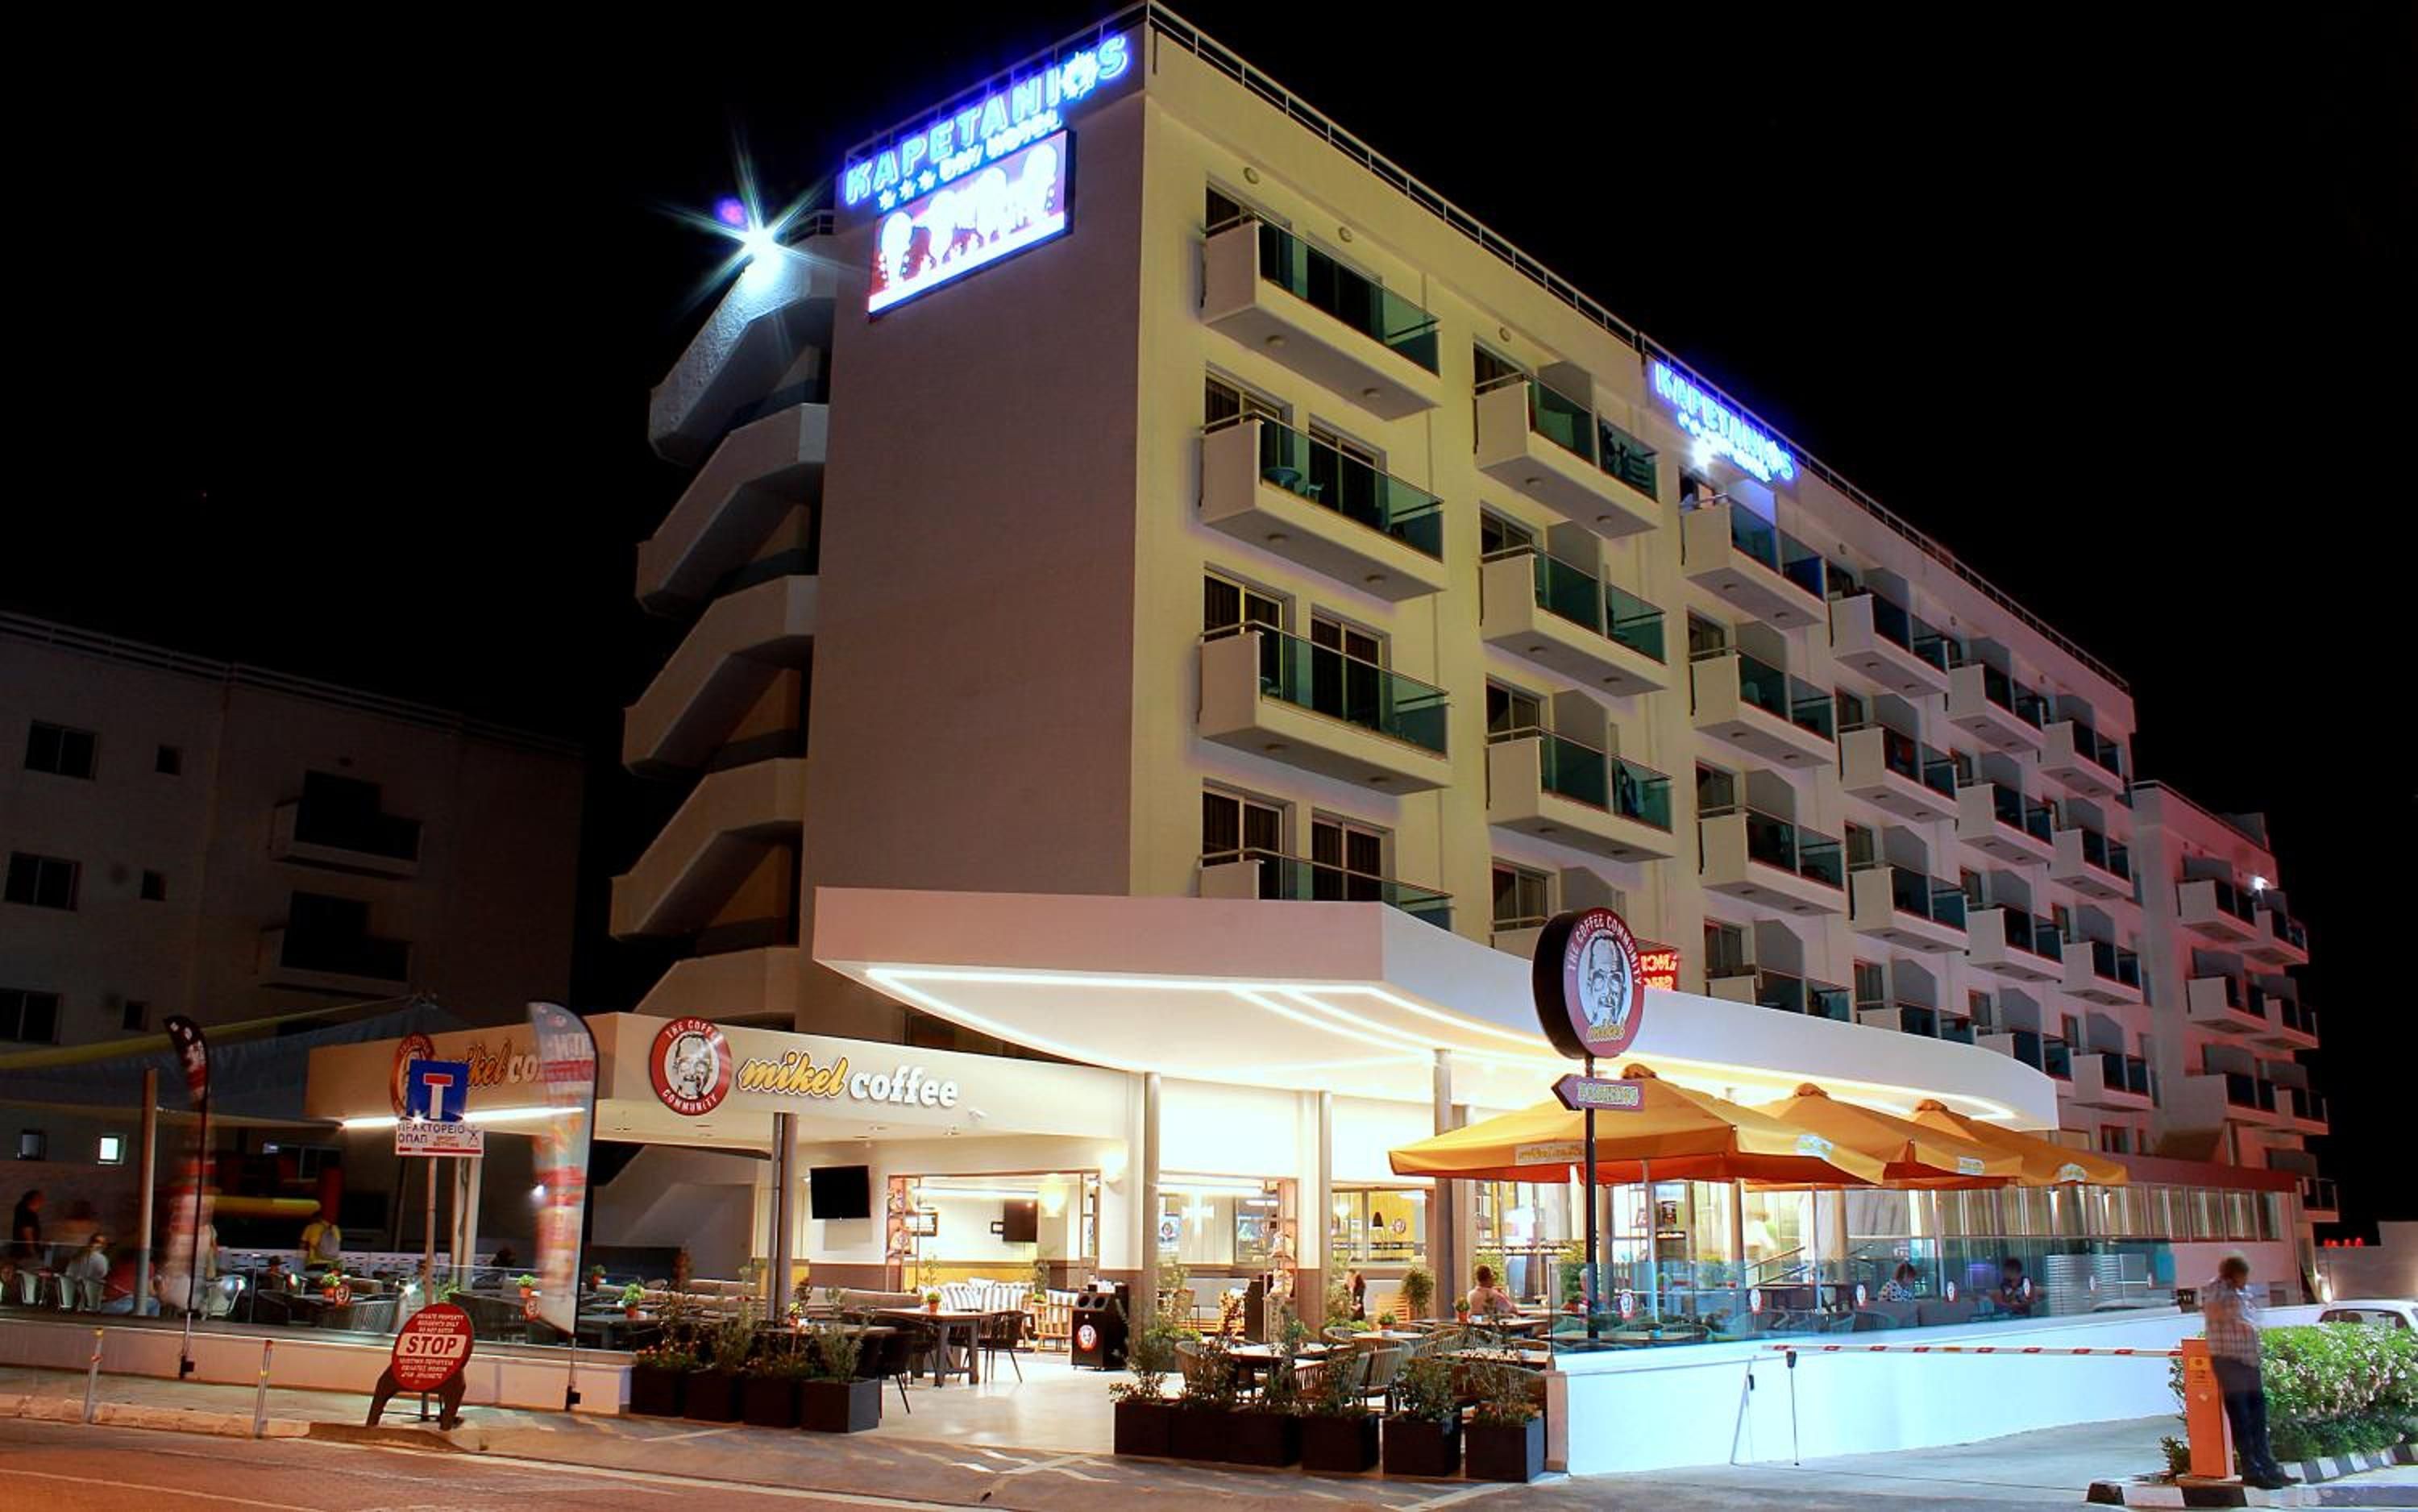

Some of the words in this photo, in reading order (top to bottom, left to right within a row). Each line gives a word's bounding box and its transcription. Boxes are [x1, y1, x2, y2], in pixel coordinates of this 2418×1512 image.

[1568, 943, 1579, 970] THE
[1576, 913, 1605, 942] COFFEE
[1606, 916, 1642, 984] COMMUNITY
[665, 1022, 684, 1038] THE
[737, 1049, 850, 1098] mikel
[850, 1065, 959, 1107] coffee
[663, 1089, 717, 1111] COMMUNITY
[406, 1335, 457, 1355] STOP
